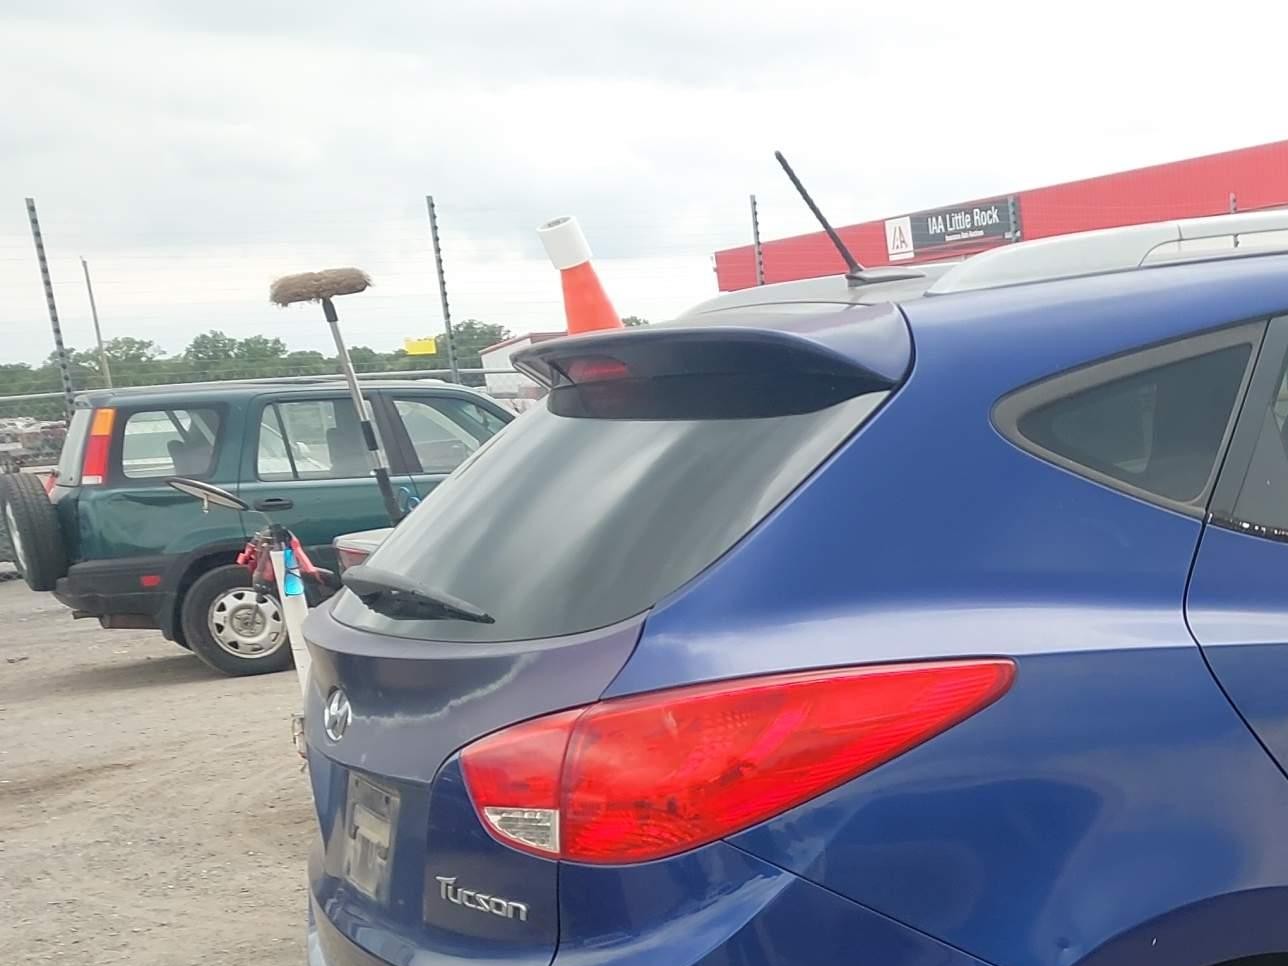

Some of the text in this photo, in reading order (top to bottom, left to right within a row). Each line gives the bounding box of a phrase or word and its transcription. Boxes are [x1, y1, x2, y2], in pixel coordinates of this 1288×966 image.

[928, 206, 1000, 234] IAA Little Rock
[435, 875, 527, 921] Tucson
